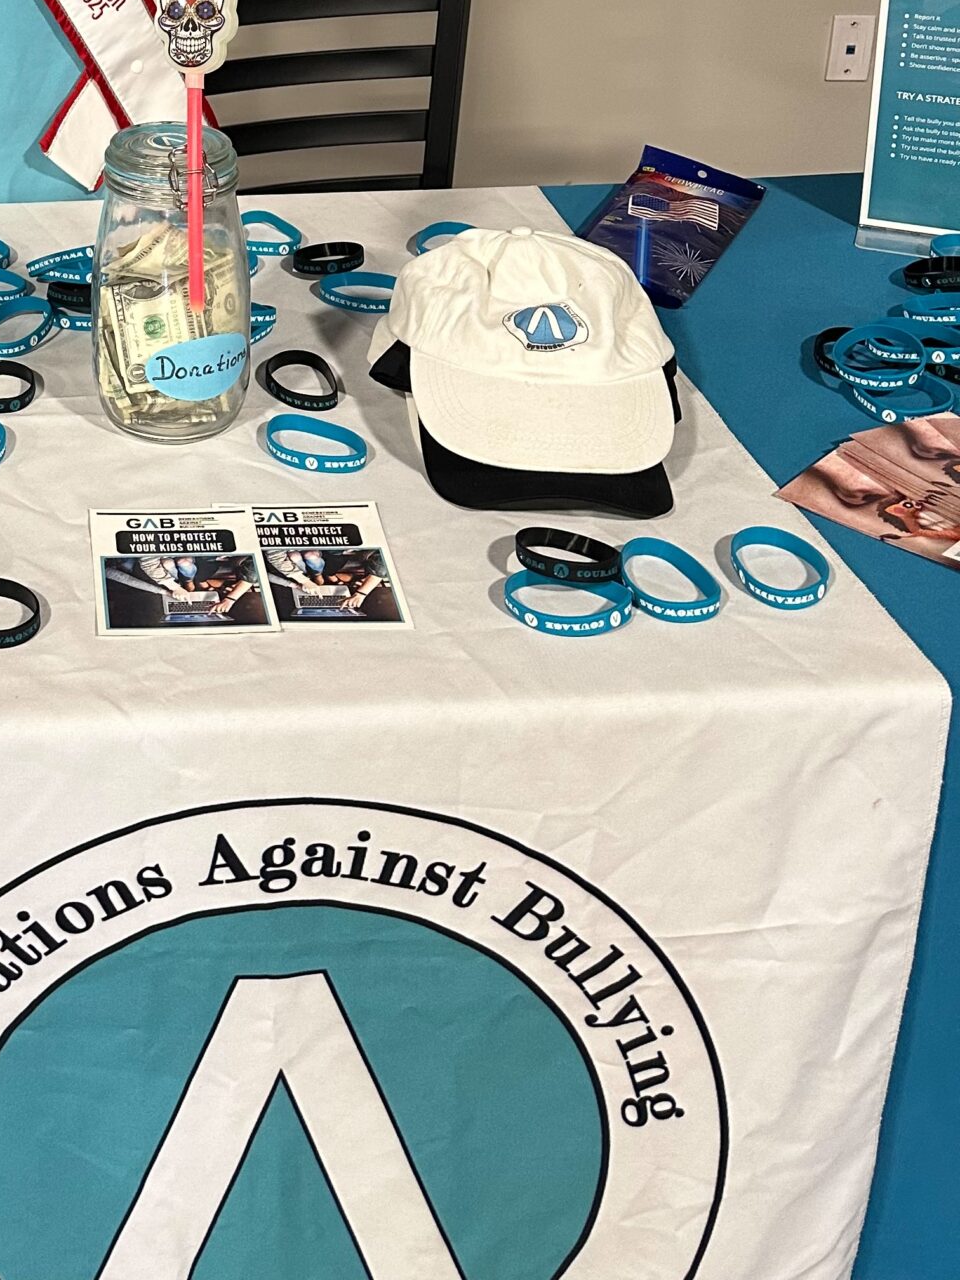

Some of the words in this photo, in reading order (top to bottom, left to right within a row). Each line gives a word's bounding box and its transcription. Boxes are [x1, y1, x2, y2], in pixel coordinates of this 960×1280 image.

[913, 24, 927, 32] Stay
[896, 91, 916, 100] TRY
[257, 527, 279, 536] HOW
[282, 527, 295, 535] TO
[298, 526, 342, 535] PROTECT
[132, 533, 155, 542] HOW
[158, 533, 171, 542] TO
[174, 532, 217, 541] PROTECT
[258, 537, 282, 546] OUR
[285, 537, 310, 545] KIDS
[312, 536, 350, 545] ONLINE
[130, 544, 157, 553] YOUR
[160, 543, 184, 552] KIDS
[186, 542, 224, 551] ONLINE
[544, 620, 605, 632] COURAGE
[195, 829, 488, 911] Against
[491, 880, 686, 1130] Bullying
